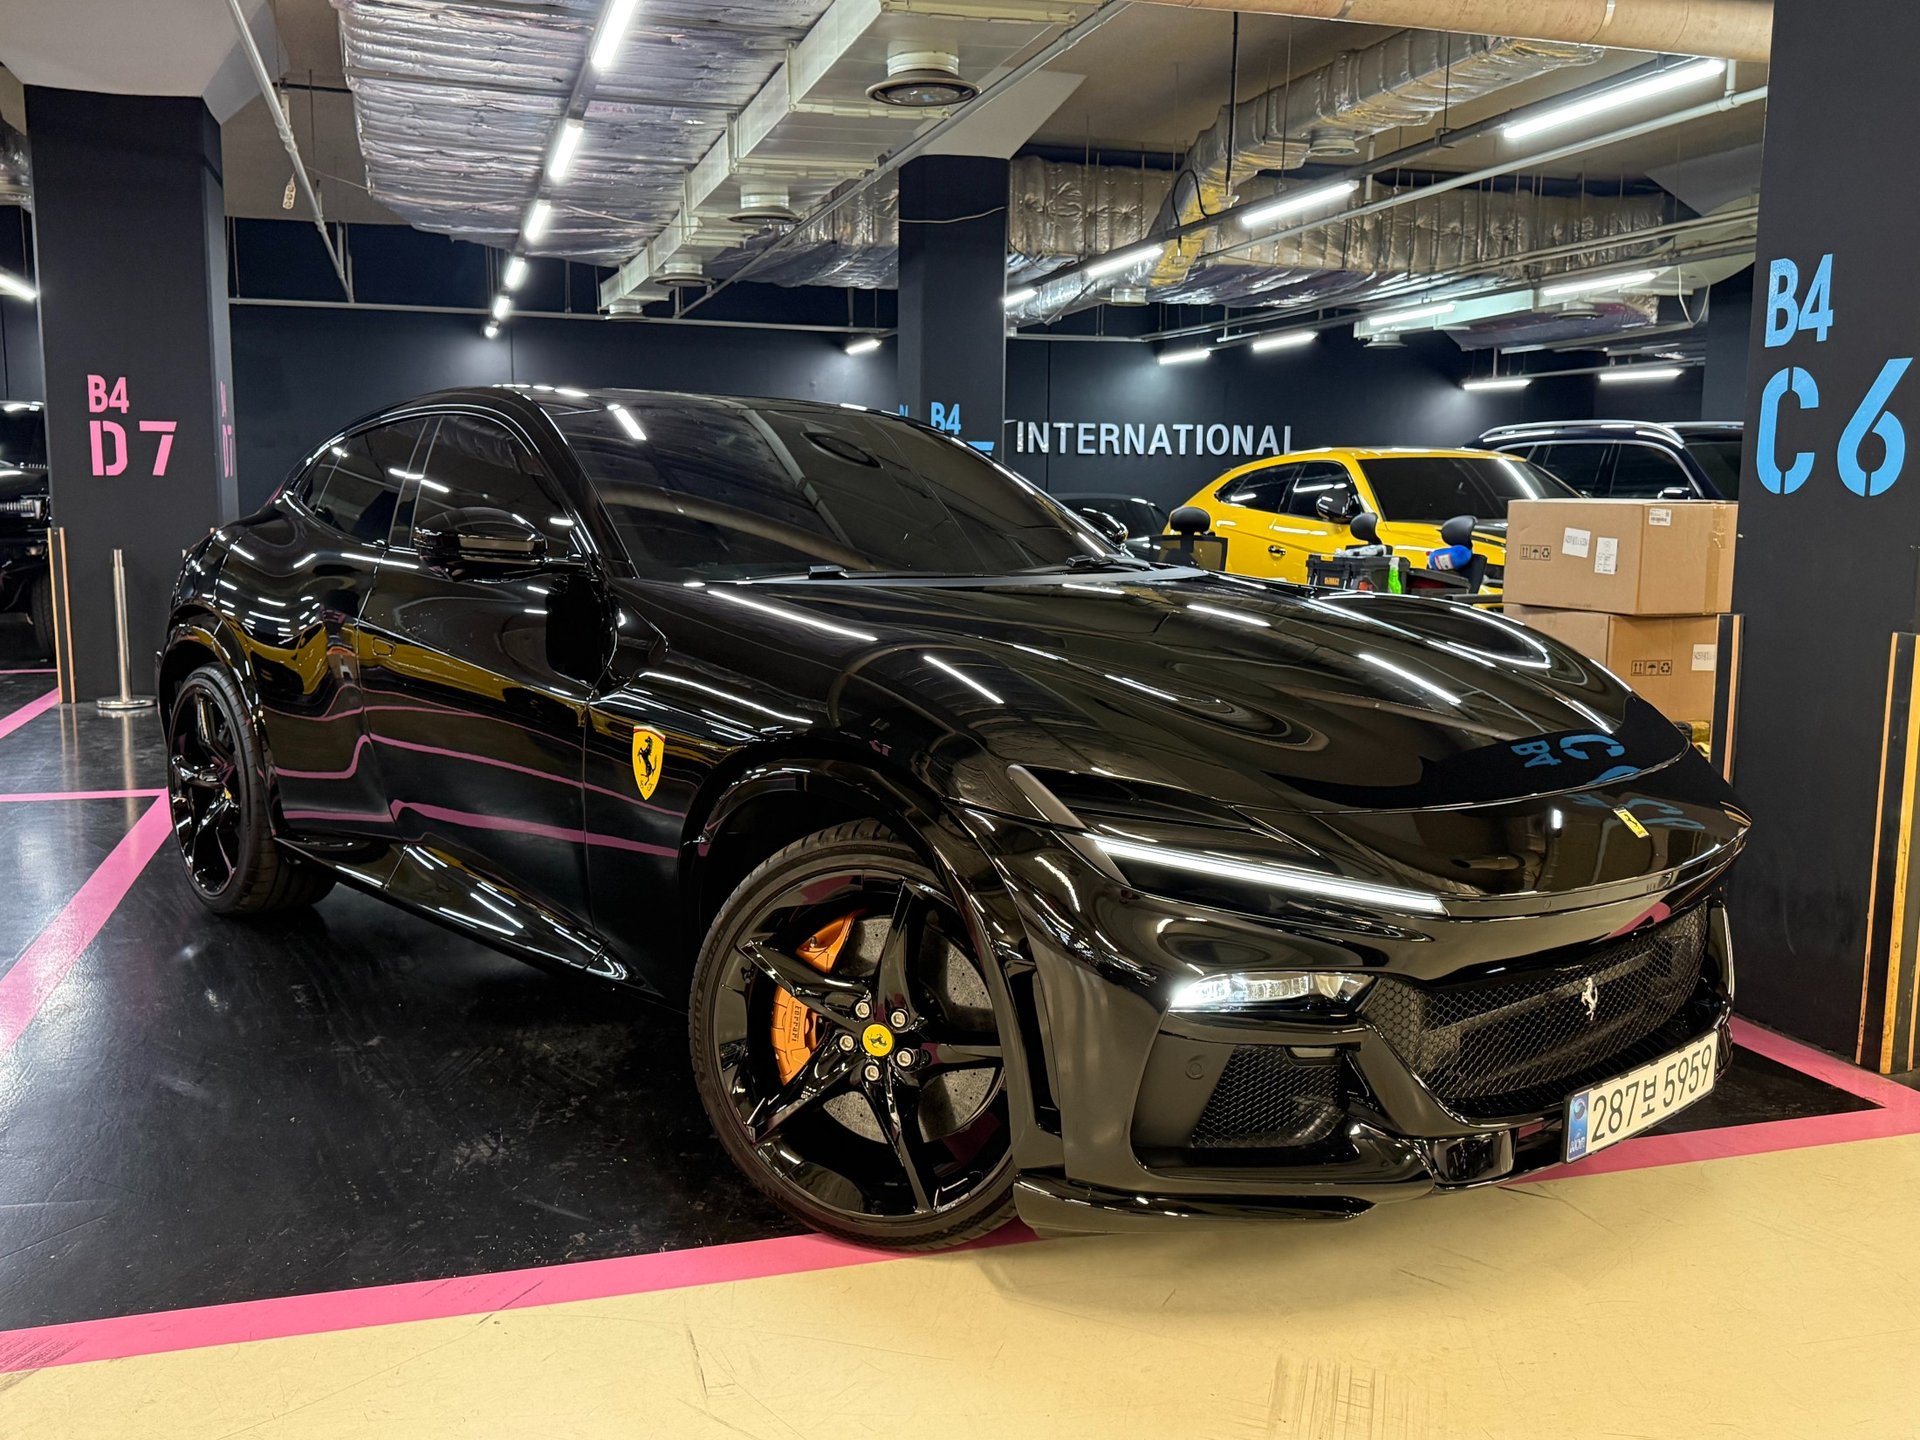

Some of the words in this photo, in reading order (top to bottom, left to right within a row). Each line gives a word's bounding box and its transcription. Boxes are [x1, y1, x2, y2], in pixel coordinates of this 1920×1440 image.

[1764, 253, 1834, 348] B4
[87, 374, 130, 414] B4
[930, 401, 961, 435] B4
[1015, 420, 1296, 456] INTERNATIONAL
[1591, 1074, 1657, 1143] 287보
[1663, 1044, 1712, 1108] 5959
